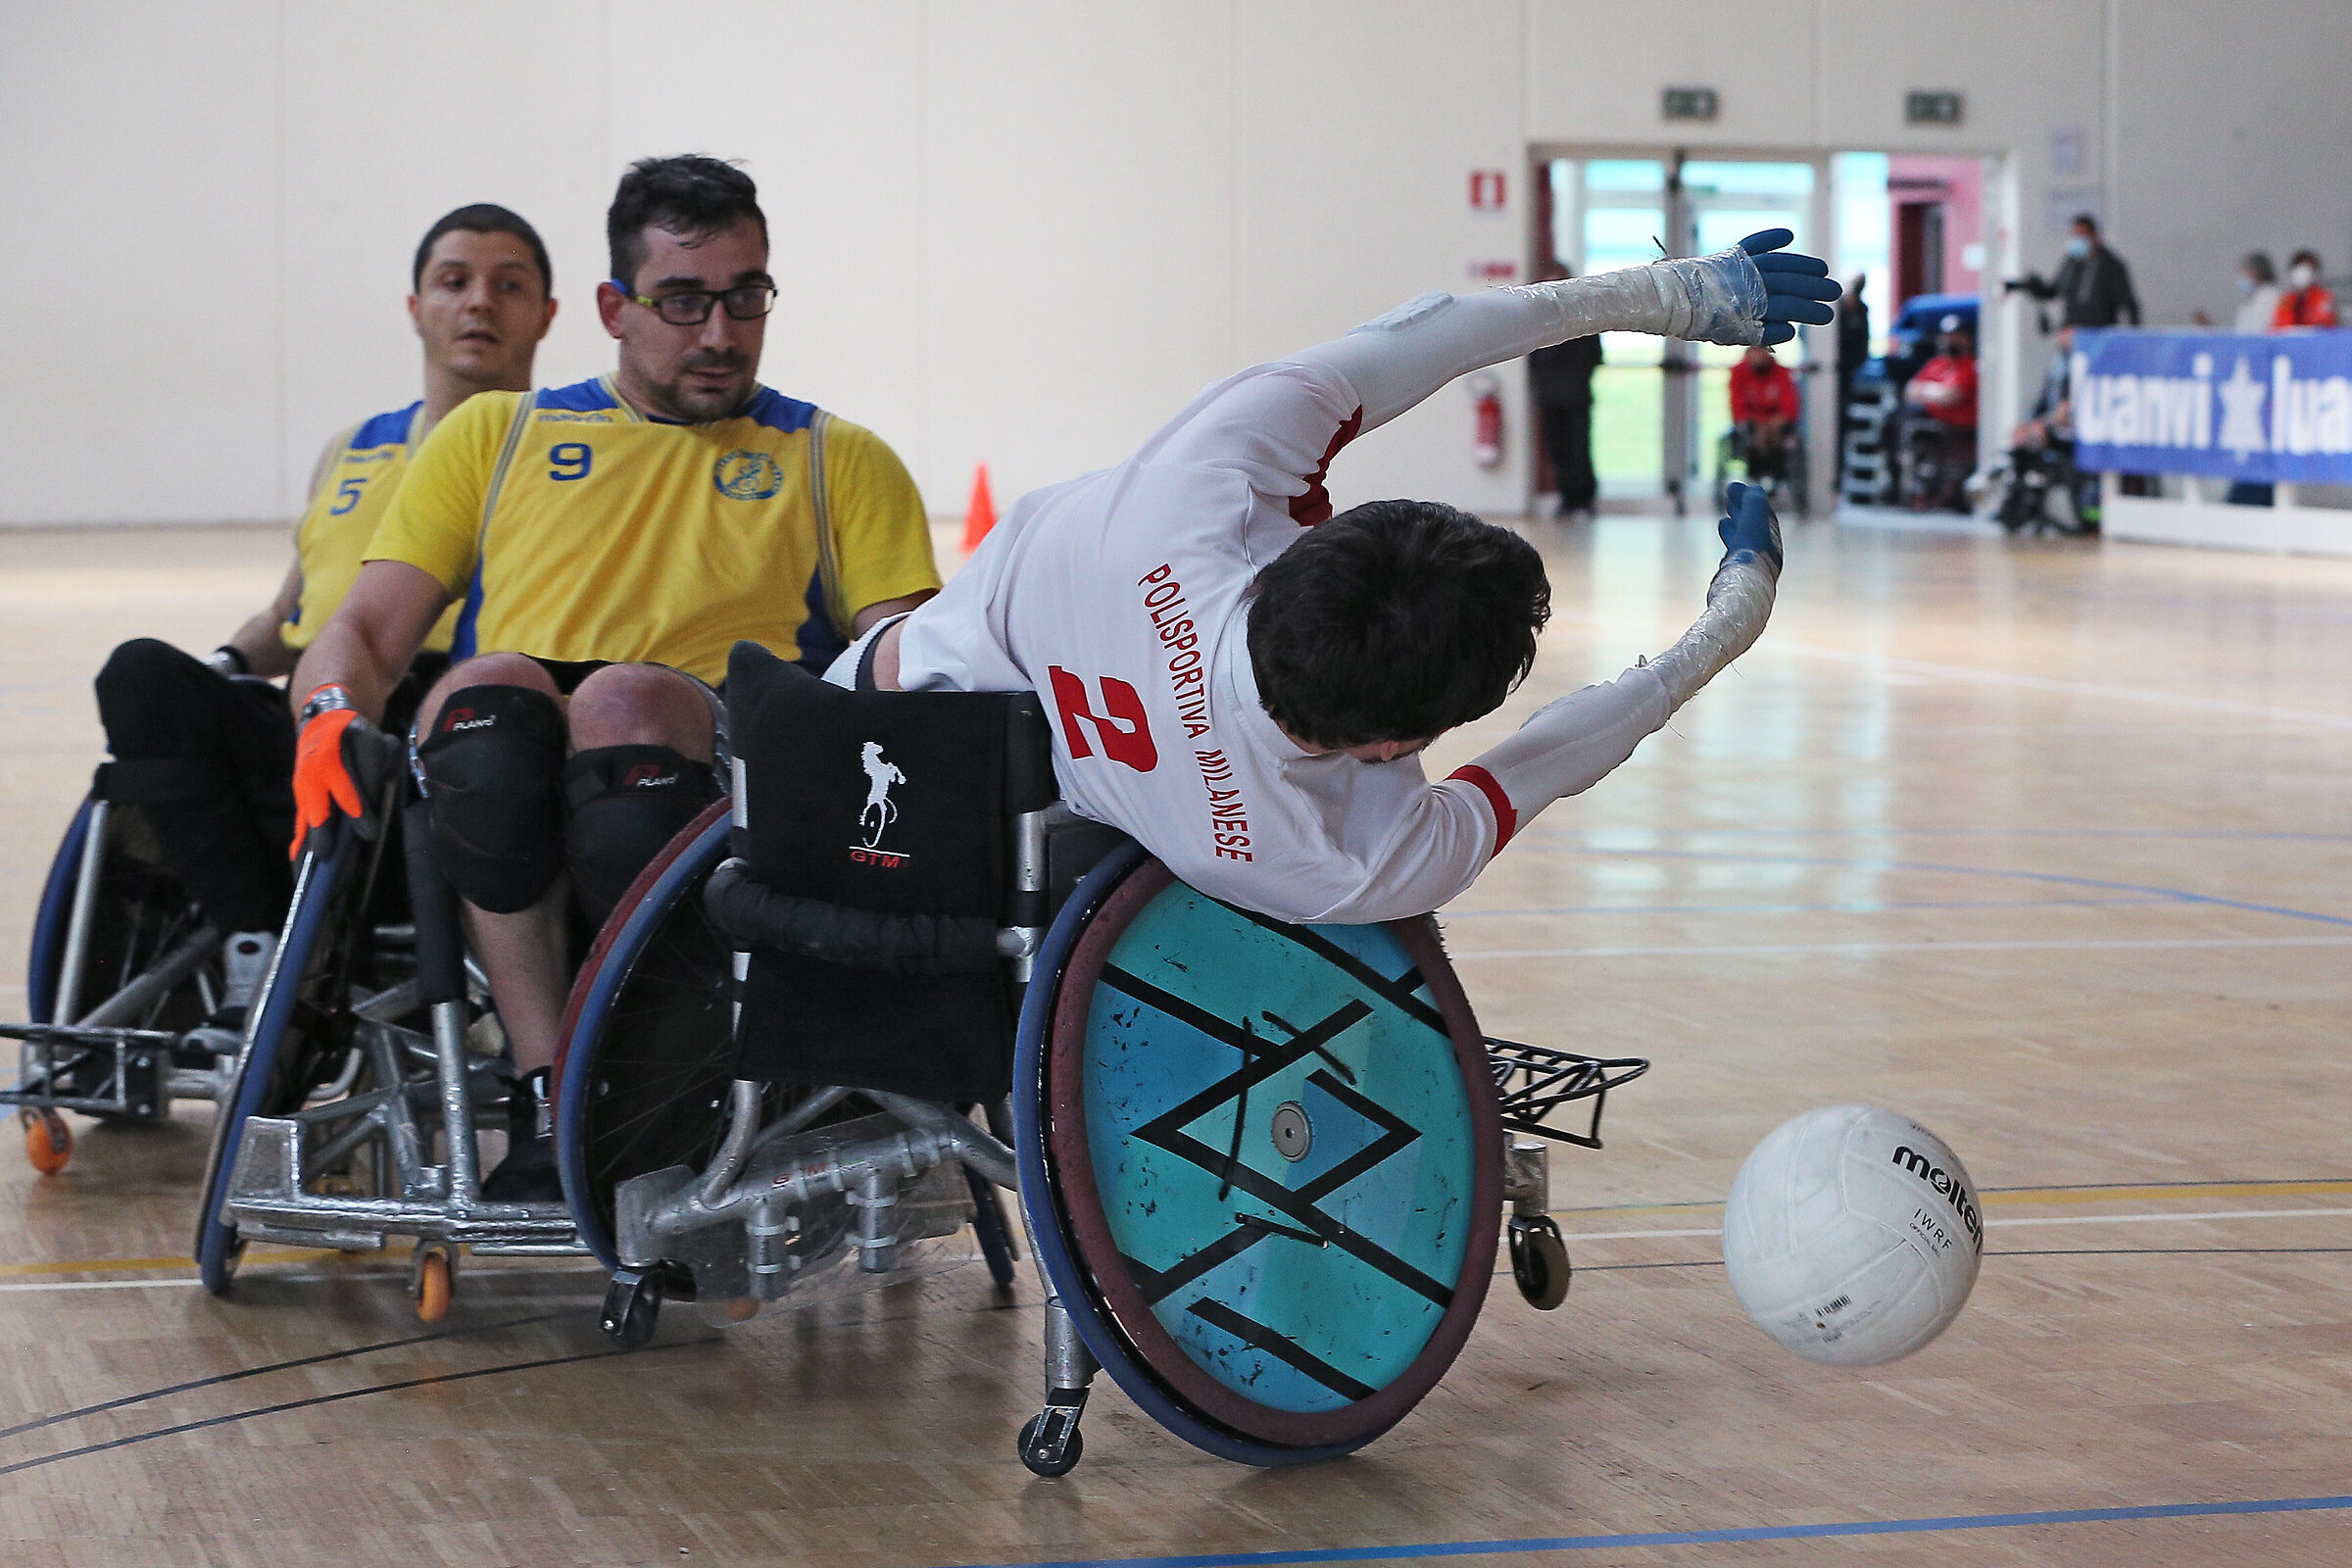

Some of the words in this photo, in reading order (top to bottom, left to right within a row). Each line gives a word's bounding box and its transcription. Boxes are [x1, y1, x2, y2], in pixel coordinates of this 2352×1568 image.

[2070, 351, 2214, 449] luanvi
[2272, 354, 2352, 455] lua
[330, 477, 369, 515] 5
[549, 443, 592, 481] 9
[1048, 665, 1158, 772] 2
[1137, 563, 1211, 739] POLISPORTIVA
[1194, 749, 1253, 862] MILANESE
[850, 851, 902, 868] GTM
[1892, 1145, 1983, 1255] molten
